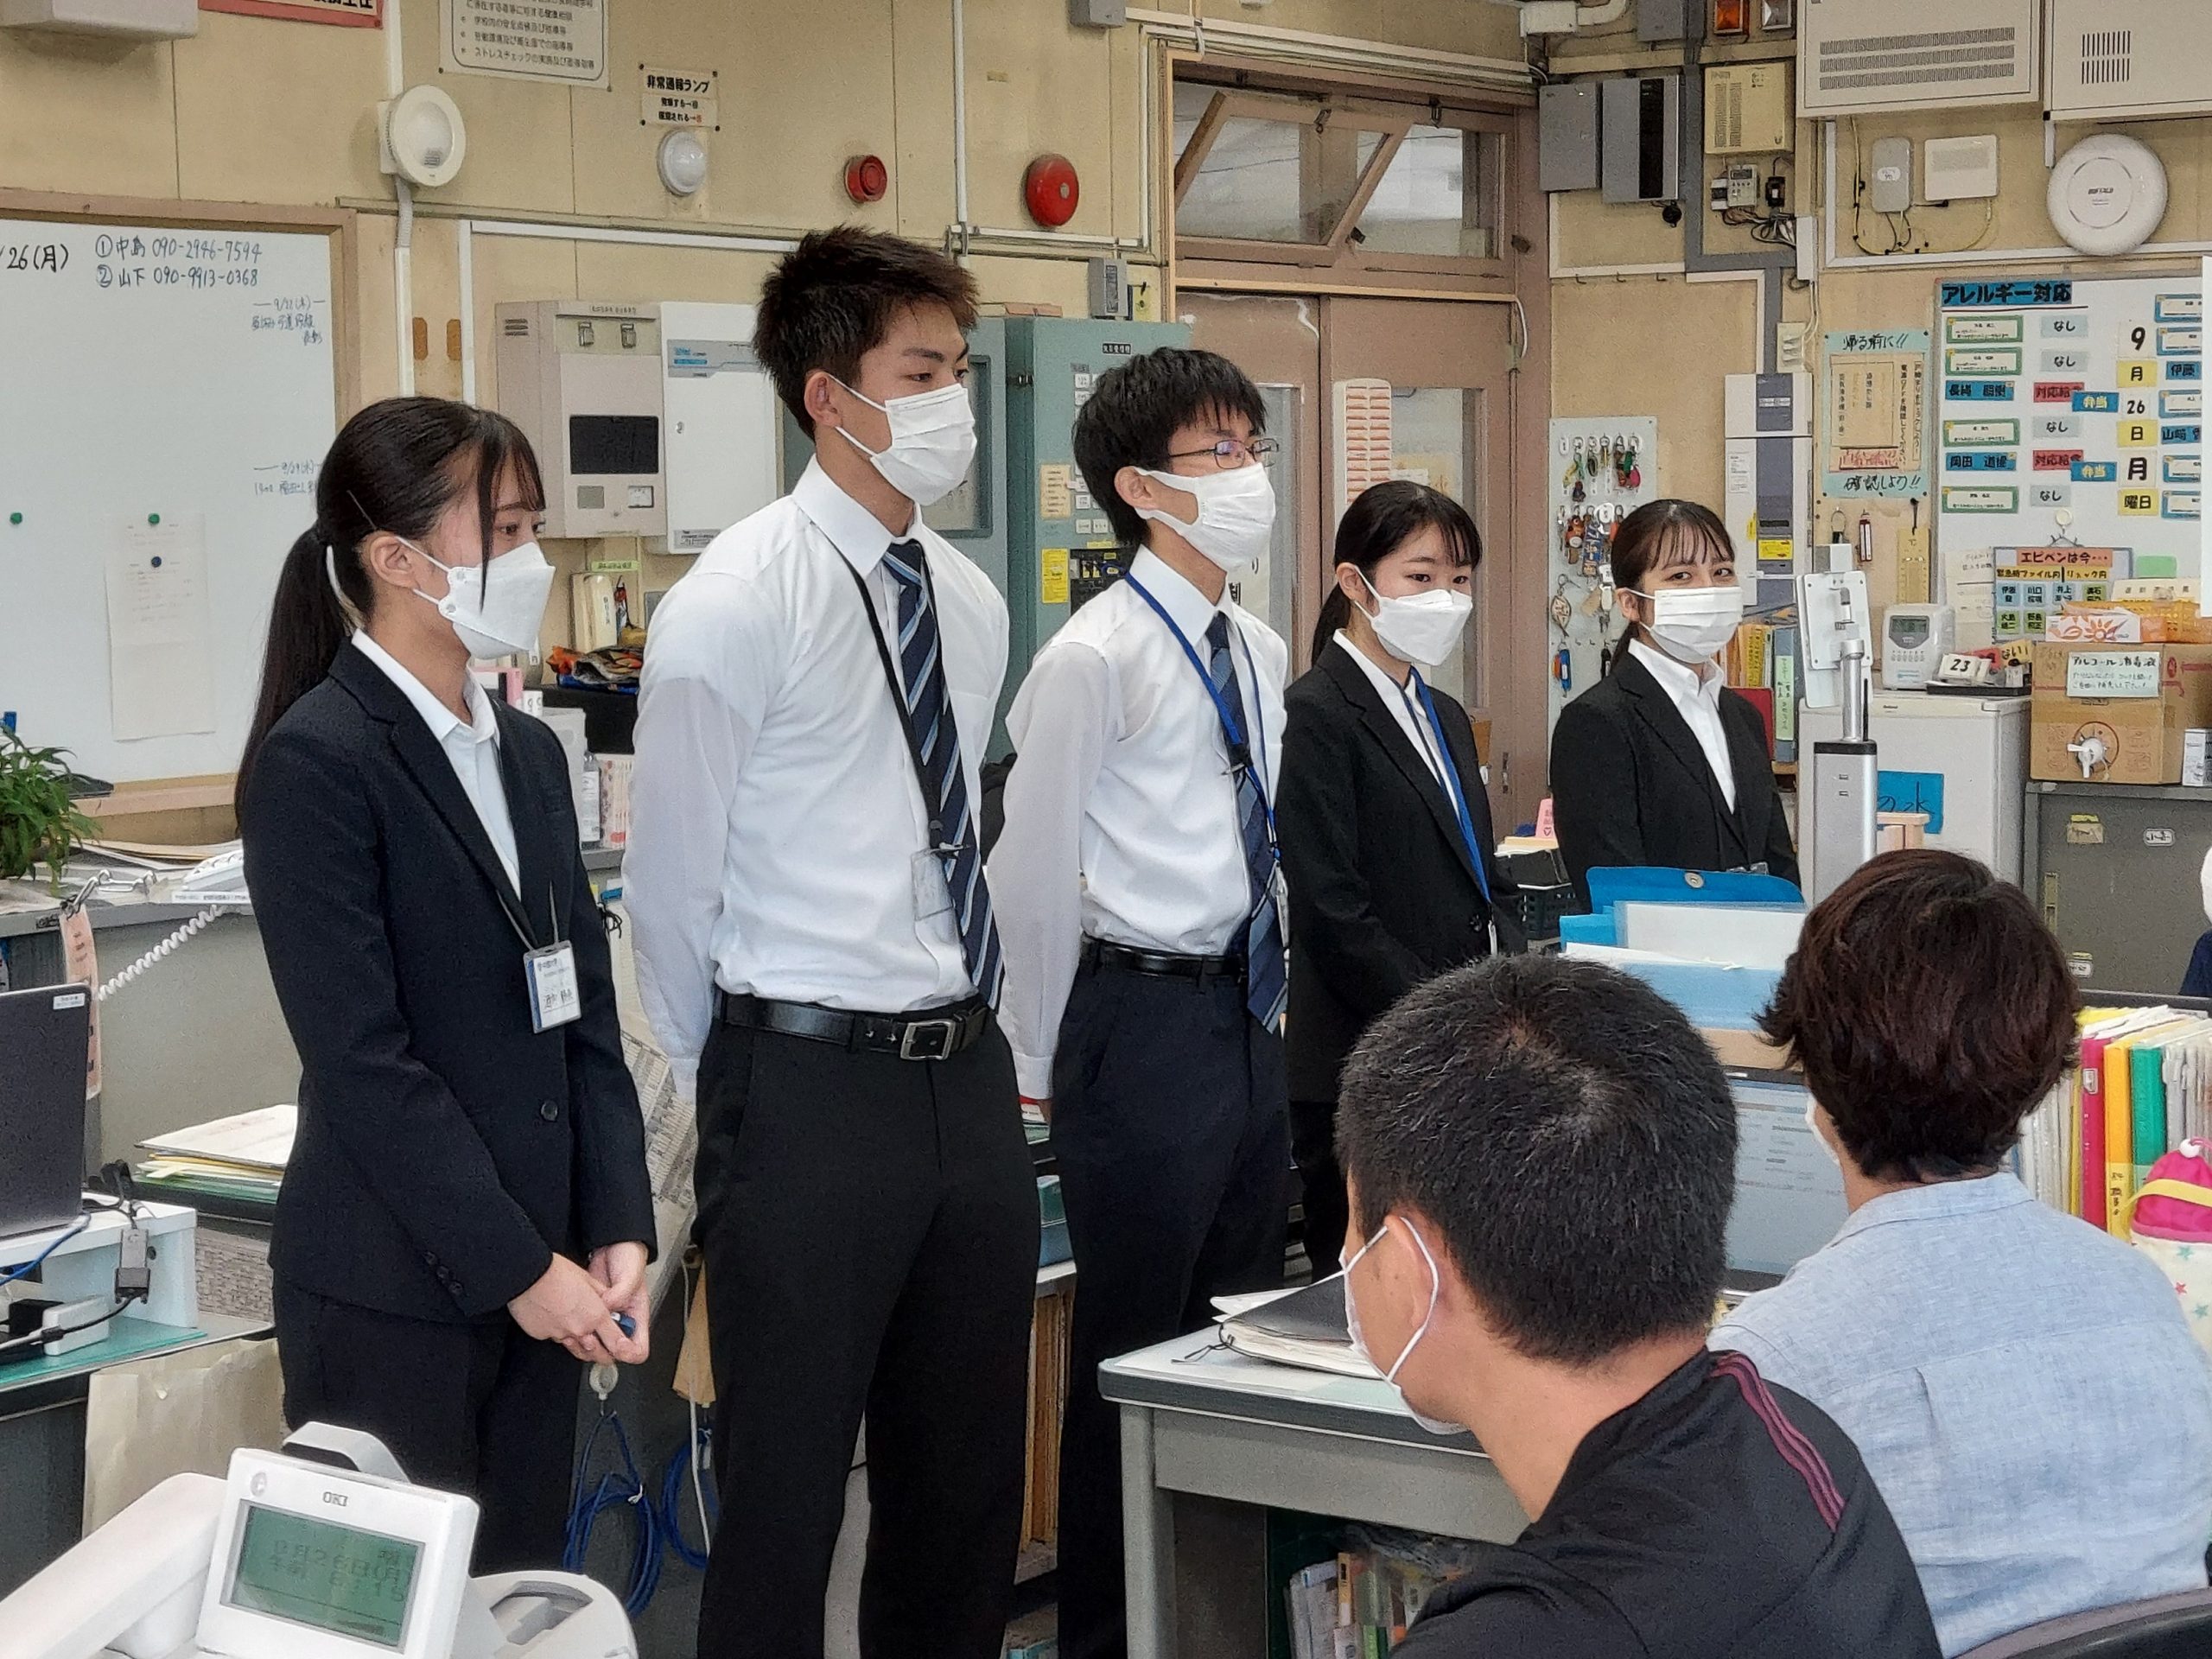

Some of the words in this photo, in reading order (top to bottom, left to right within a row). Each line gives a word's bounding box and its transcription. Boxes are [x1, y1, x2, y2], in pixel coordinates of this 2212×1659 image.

[1942, 283, 2072, 303] アレルギー対応
[2053, 321, 2076, 333] なし
[2130, 327, 2146, 351] 9
[2053, 355, 2076, 368] なし
[2130, 365, 2144, 382] 月
[2082, 396, 2108, 410] 弁当
[2126, 400, 2145, 415] 26
[2045, 421, 2069, 433] なし
[2131, 426, 2144, 442] 日
[2082, 464, 2107, 479] 弁当
[2127, 456, 2148, 481] 月
[2039, 489, 2062, 501] なし
[2124, 494, 2152, 510] 曜日
[1949, 658, 1971, 672] 23
